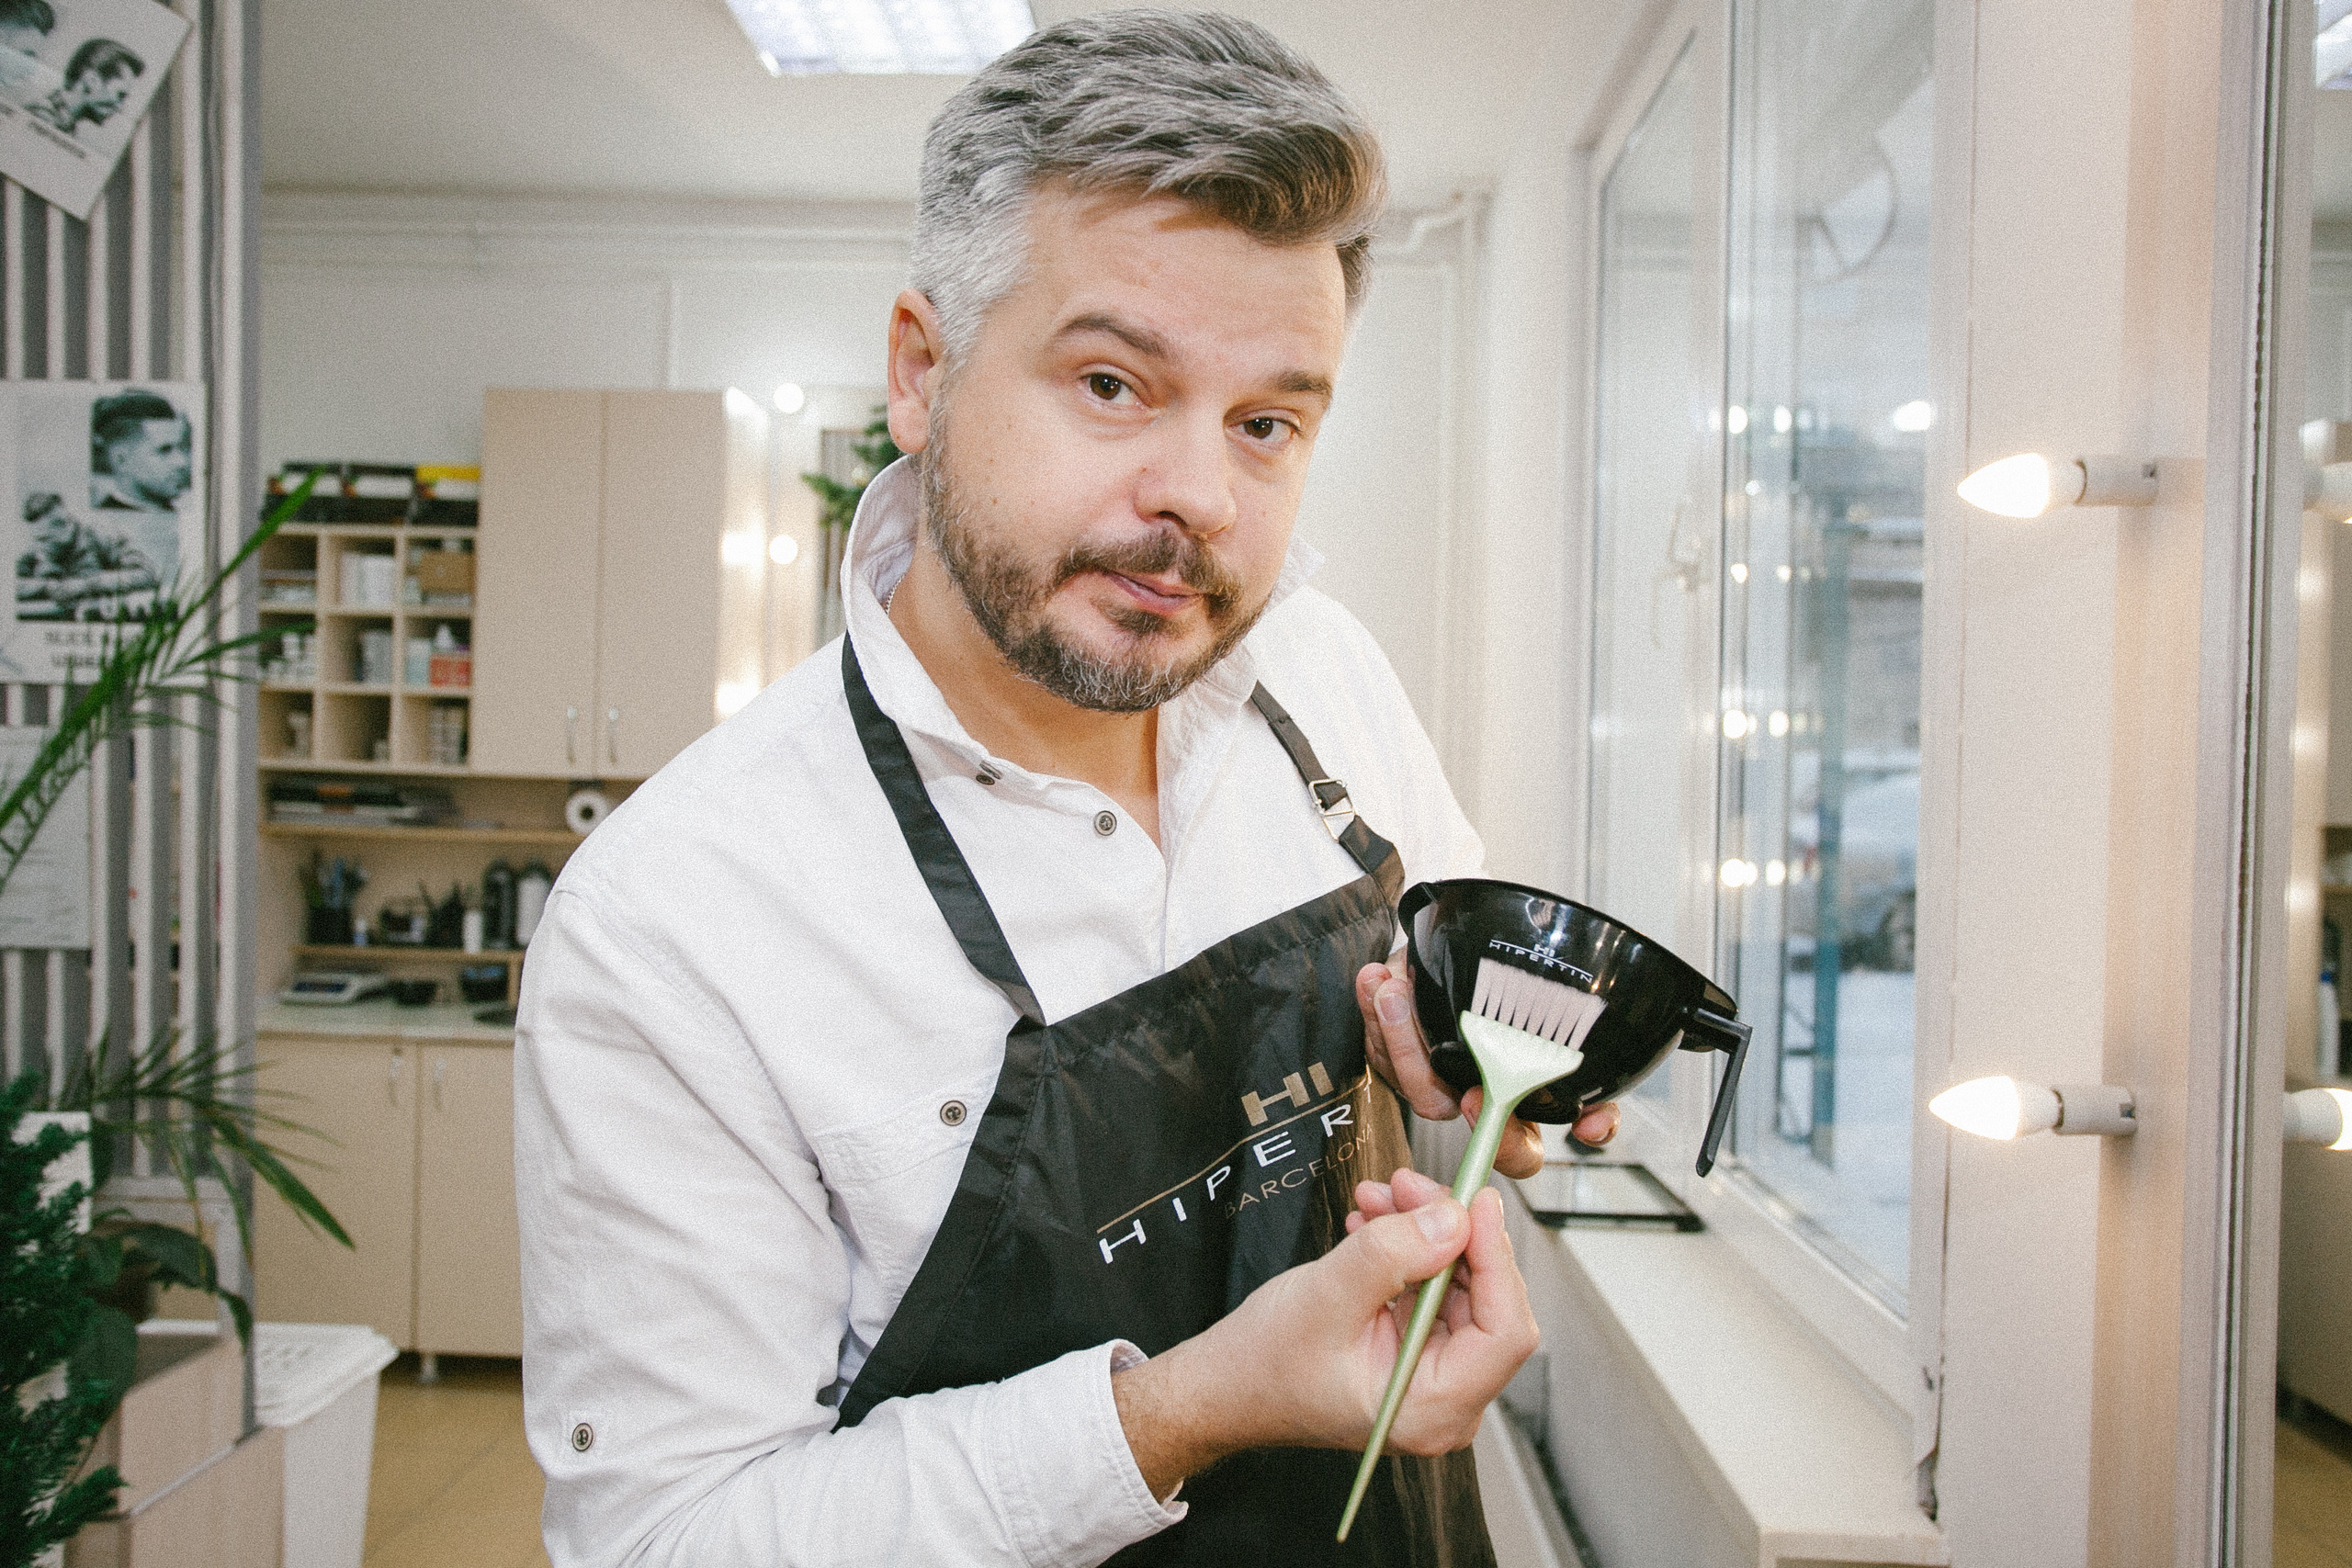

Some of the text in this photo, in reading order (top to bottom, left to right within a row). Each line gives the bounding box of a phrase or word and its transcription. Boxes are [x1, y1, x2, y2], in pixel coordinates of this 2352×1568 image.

[1488, 942, 1592, 984] HIPERTIN
[1533, 943, 1555, 957] HI
[1241, 1061, 1334, 1126] HI
